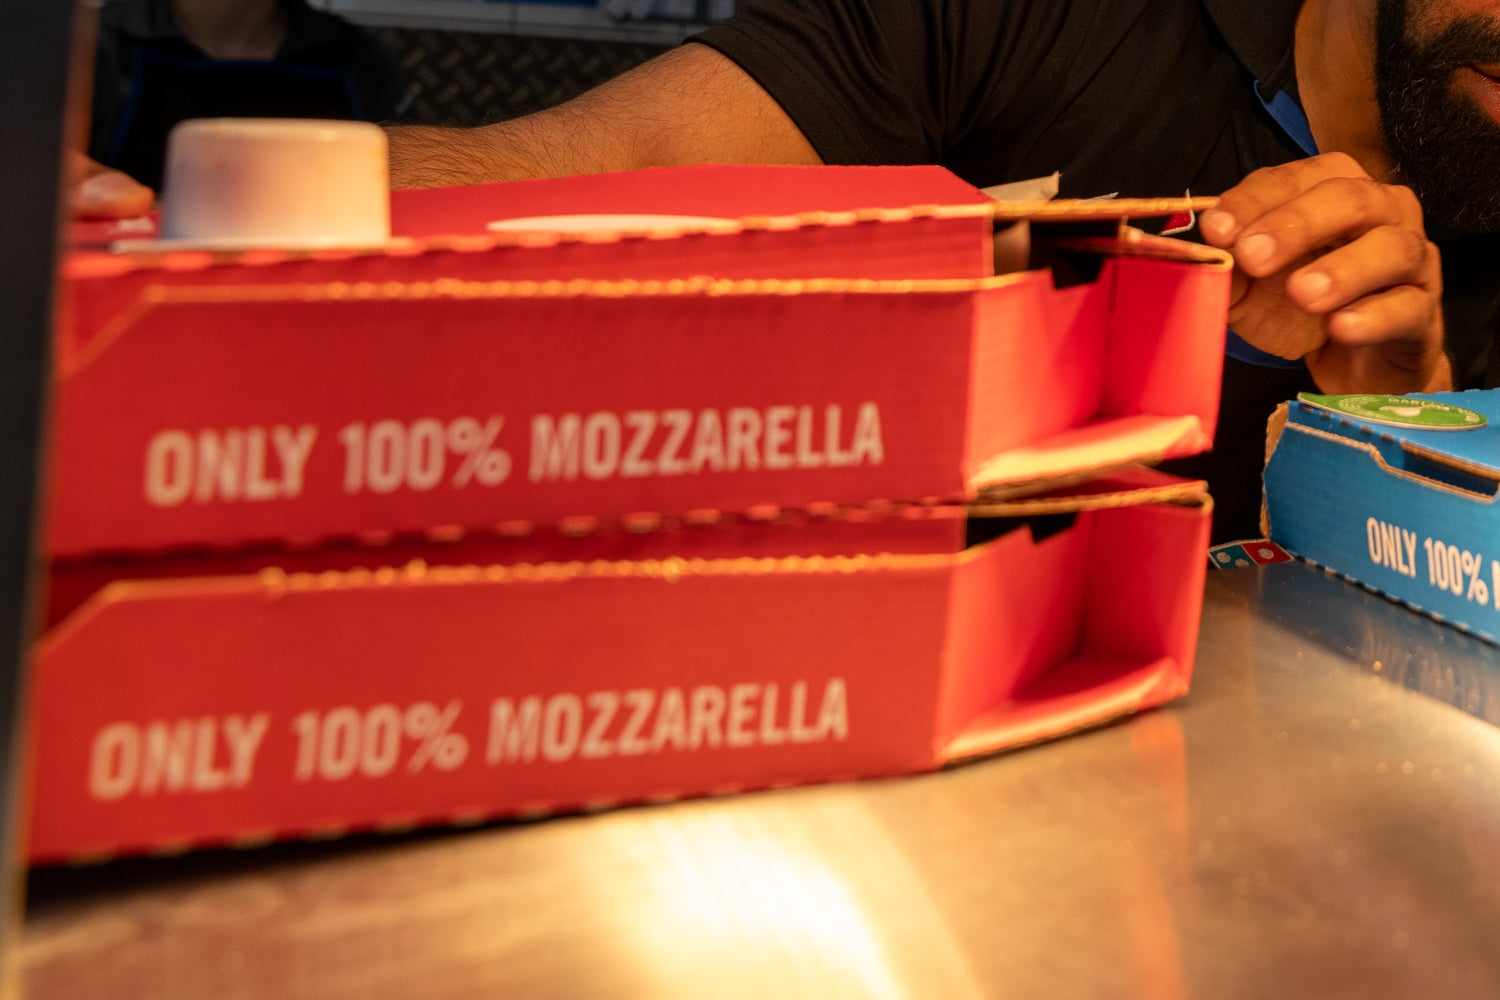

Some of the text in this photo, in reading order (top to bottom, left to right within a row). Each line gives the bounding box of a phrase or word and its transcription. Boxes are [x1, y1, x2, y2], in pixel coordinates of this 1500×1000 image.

[146, 402, 883, 507] ONLY 100% MOZZARELLA
[1366, 516, 1416, 579] ONLY
[1424, 537, 1488, 607] 100%
[90, 679, 848, 801] ONLY 100% MOZZARELLA
